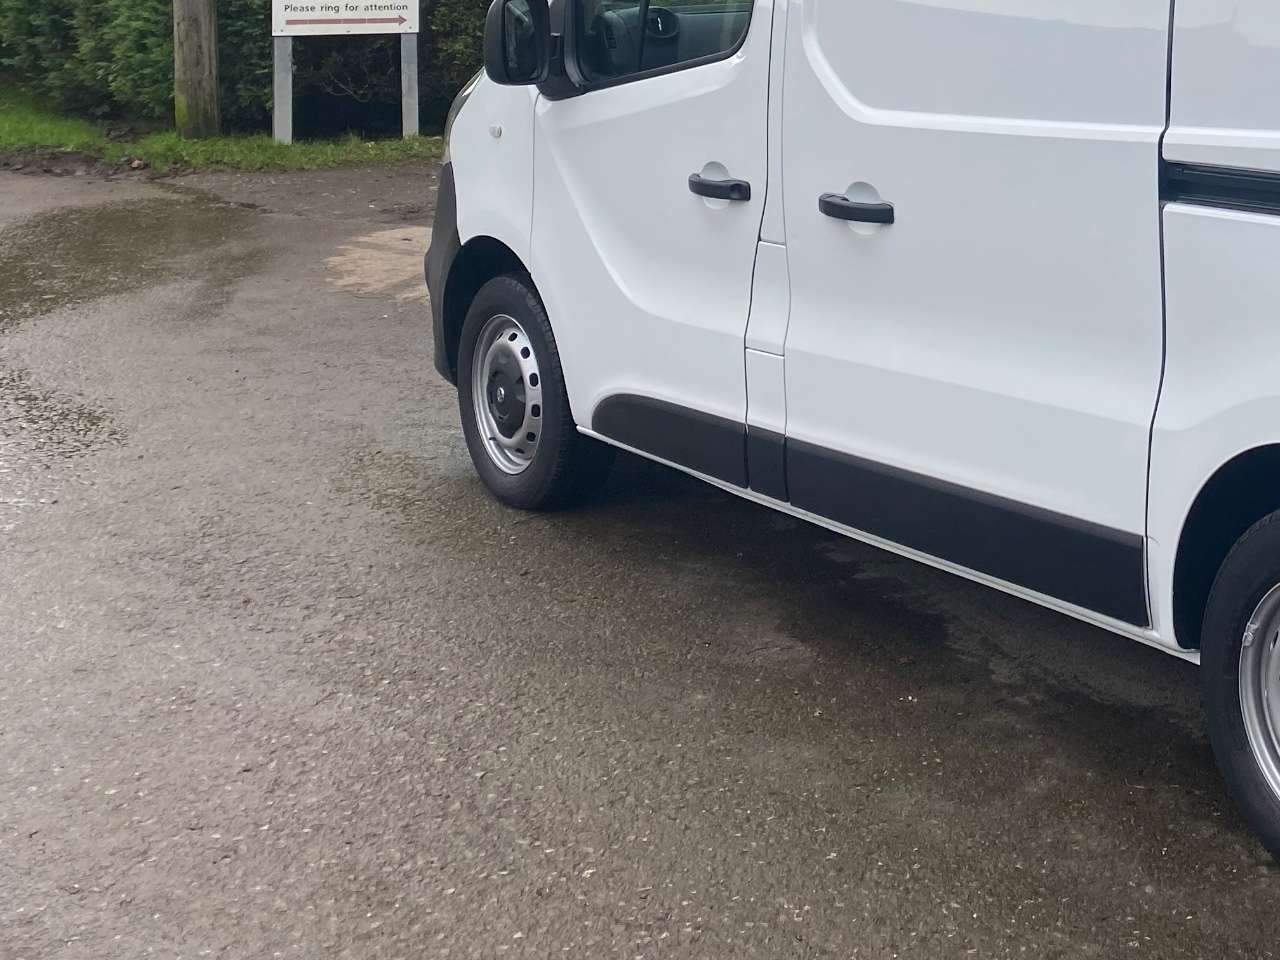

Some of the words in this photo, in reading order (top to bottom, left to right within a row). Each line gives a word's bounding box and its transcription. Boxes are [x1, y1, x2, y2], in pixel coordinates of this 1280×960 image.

[284, 3, 316, 12] Please
[320, 3, 340, 14] ring
[345, 3, 359, 11] for
[364, 3, 408, 11] attention
